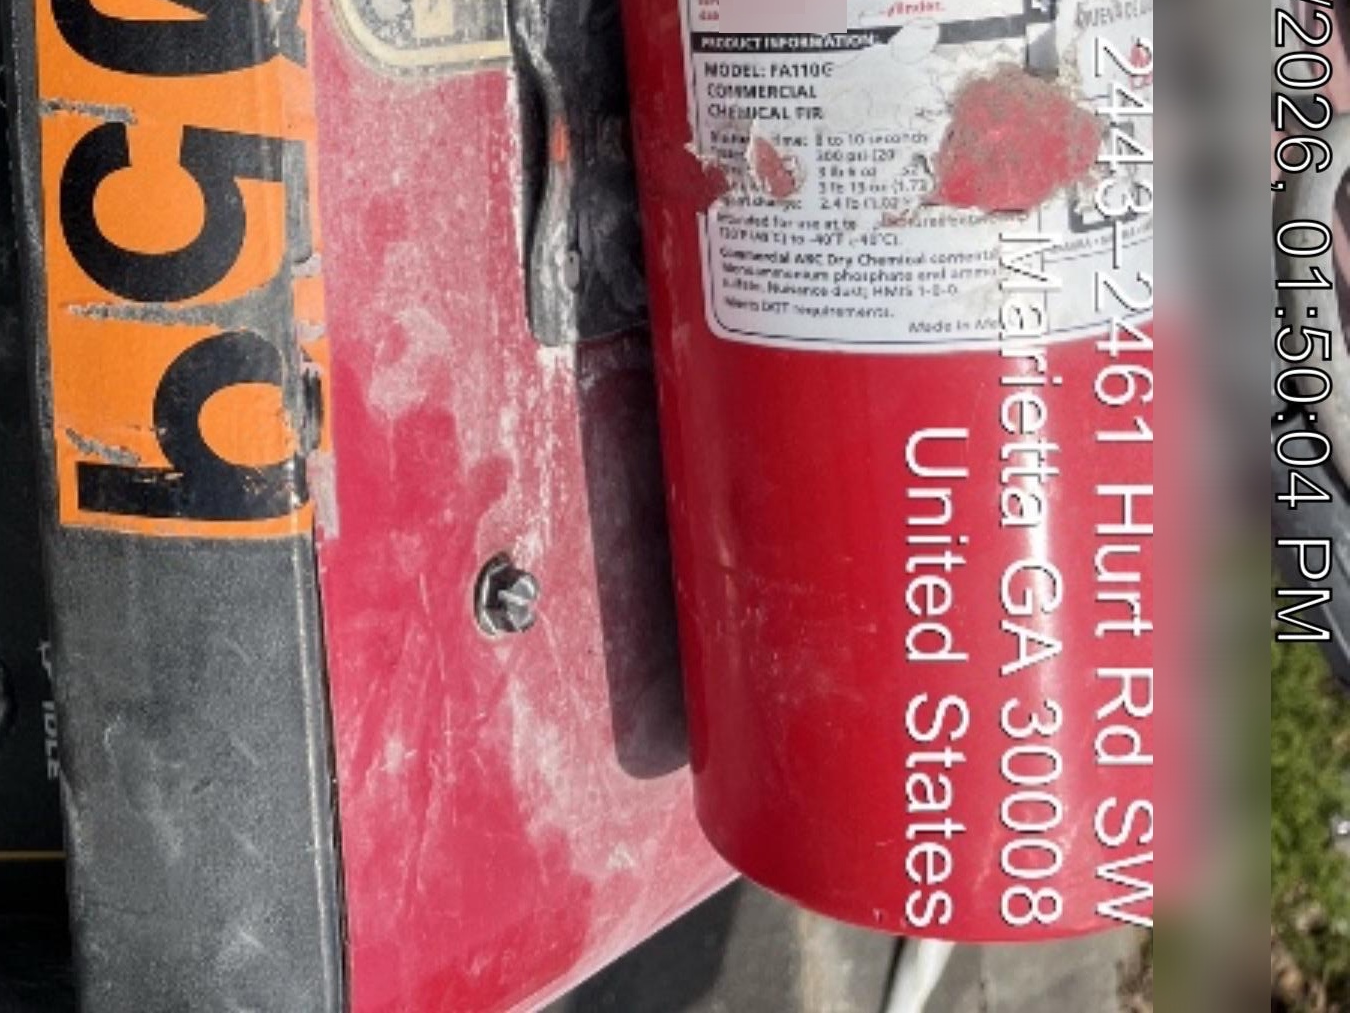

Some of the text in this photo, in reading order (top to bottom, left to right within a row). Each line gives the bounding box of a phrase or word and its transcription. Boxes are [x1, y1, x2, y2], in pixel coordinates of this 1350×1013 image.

[703, 61, 766, 79] MODEL:
[706, 85, 818, 100] COMMERCIAL
[707, 104, 824, 120] CHEMICAL FIR
